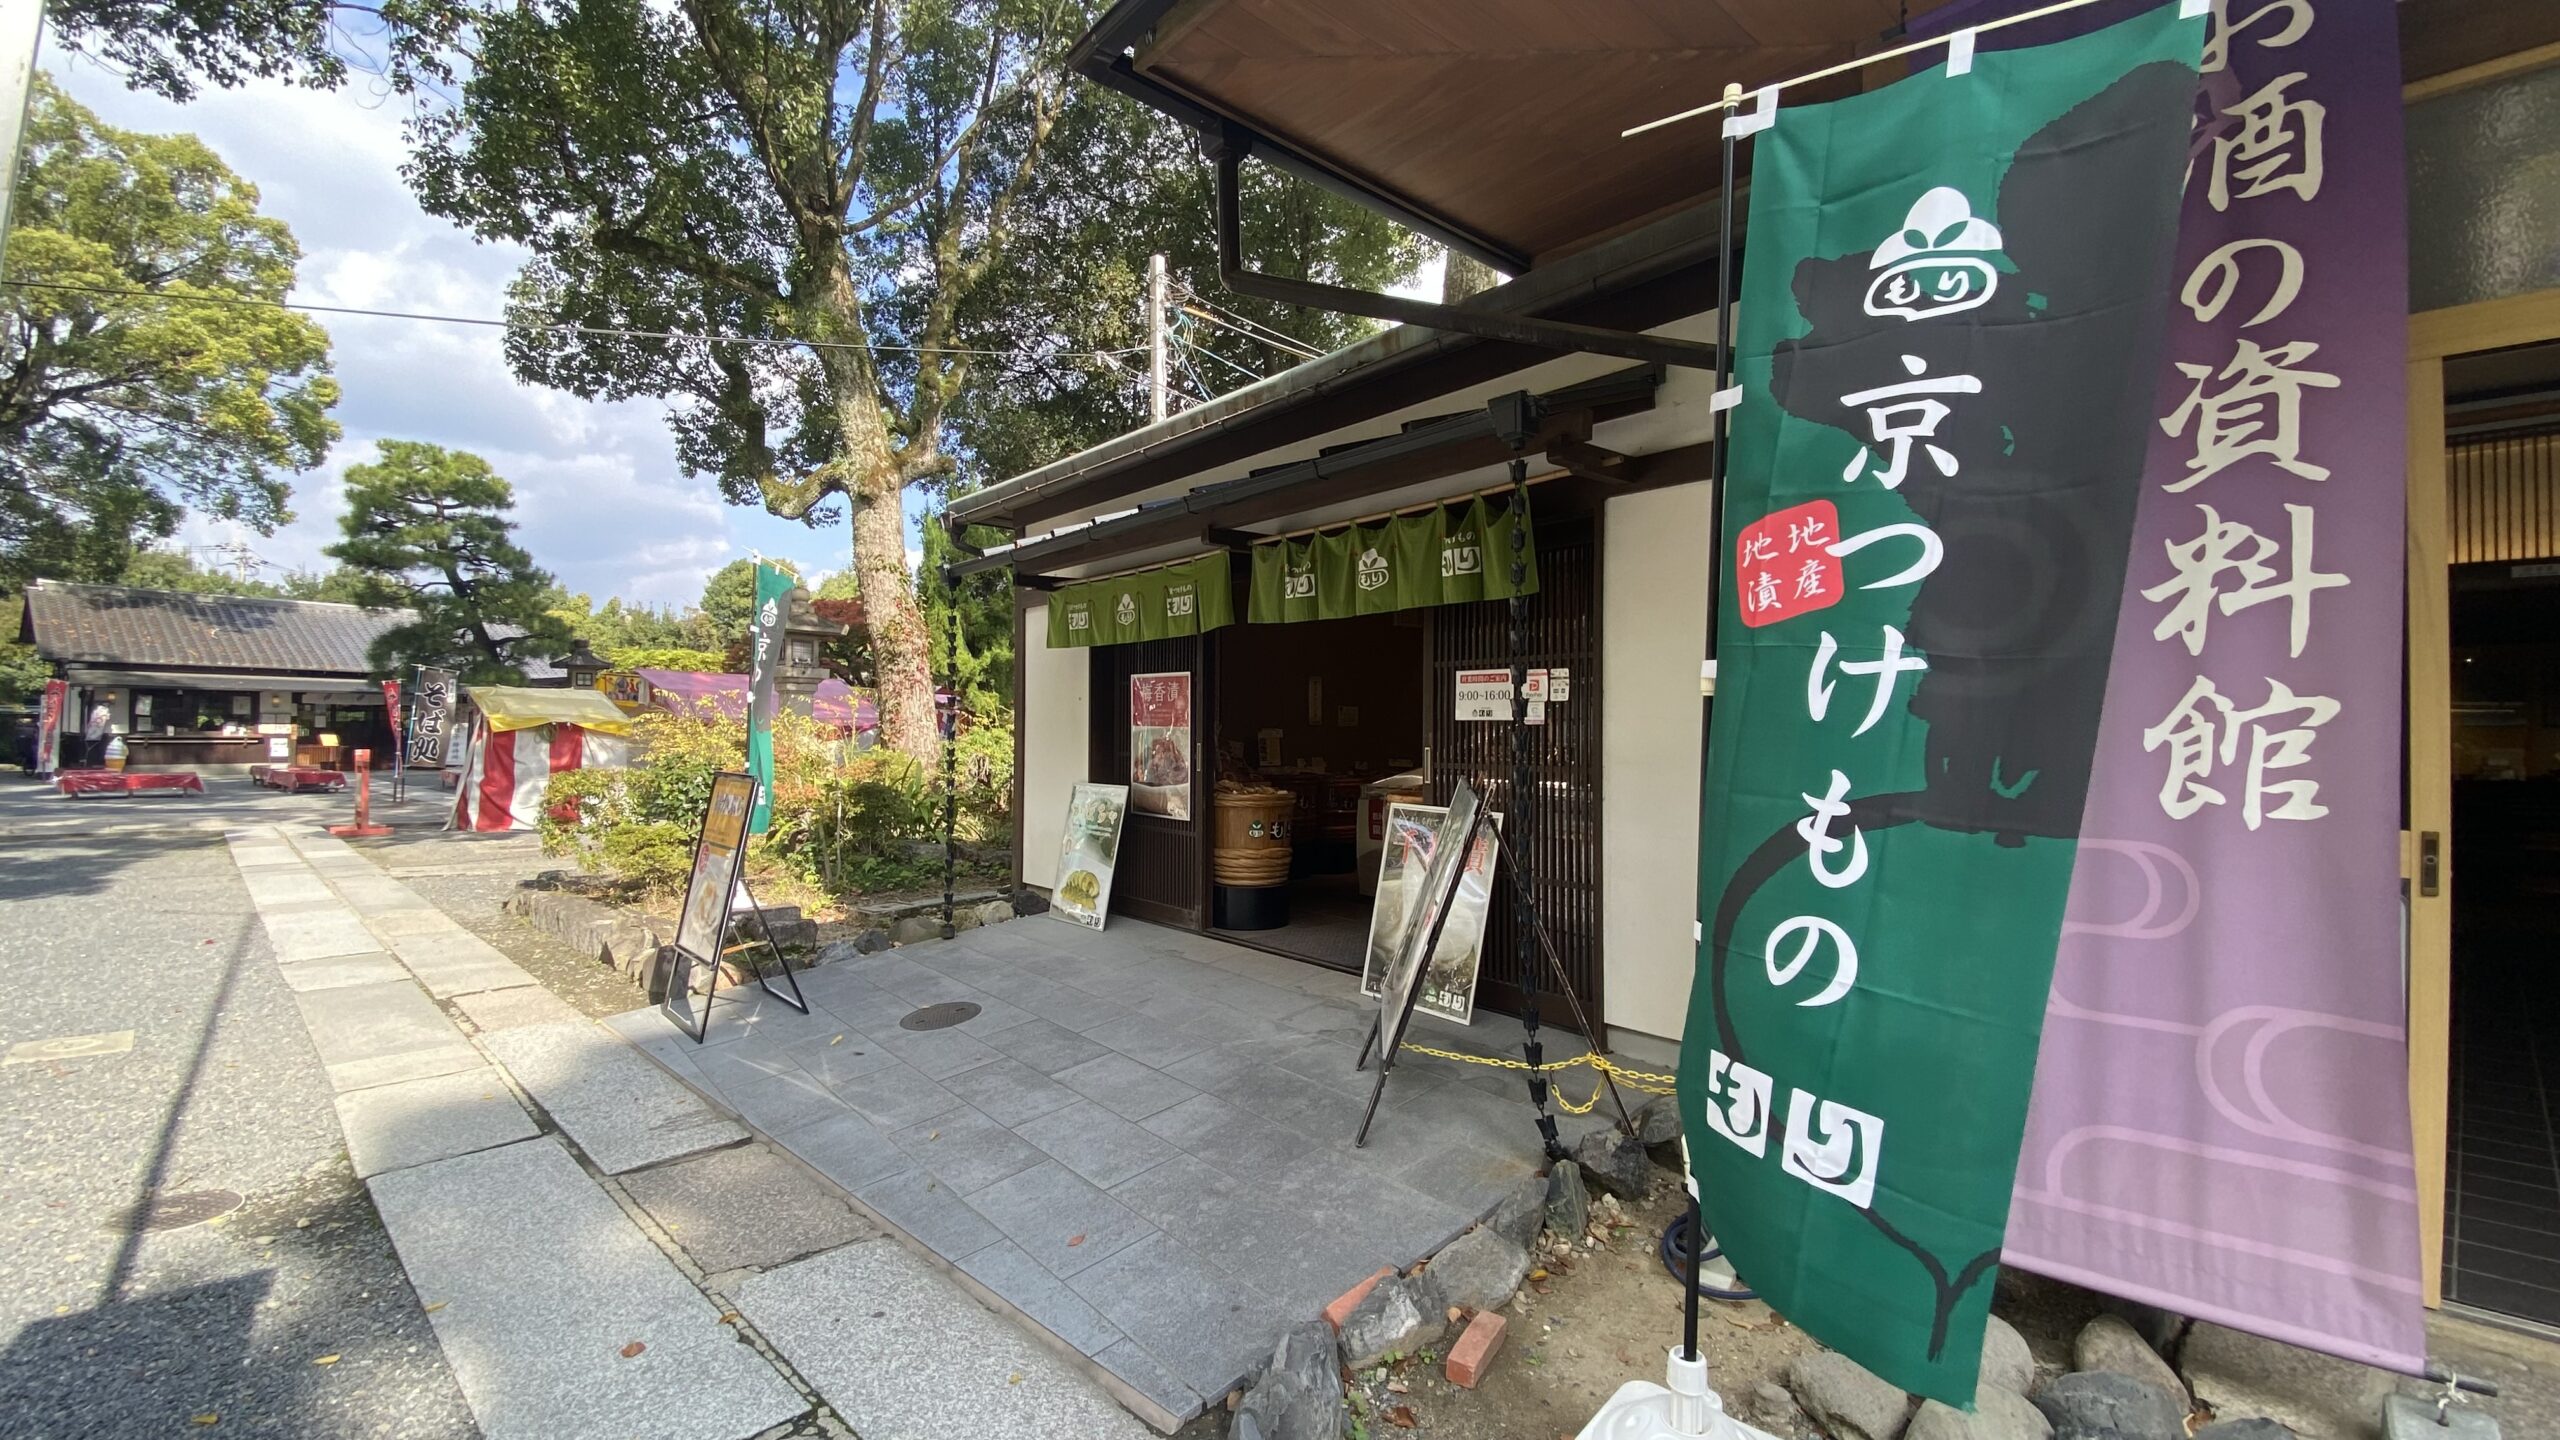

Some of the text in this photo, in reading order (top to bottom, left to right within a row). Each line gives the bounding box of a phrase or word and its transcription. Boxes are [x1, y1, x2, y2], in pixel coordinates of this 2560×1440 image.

[1167, 595, 1193, 617] もり
[411, 681, 447, 763] そば処
[1765, 355, 1982, 1007] 京つけもの
[1707, 1048, 1884, 1209] もり
